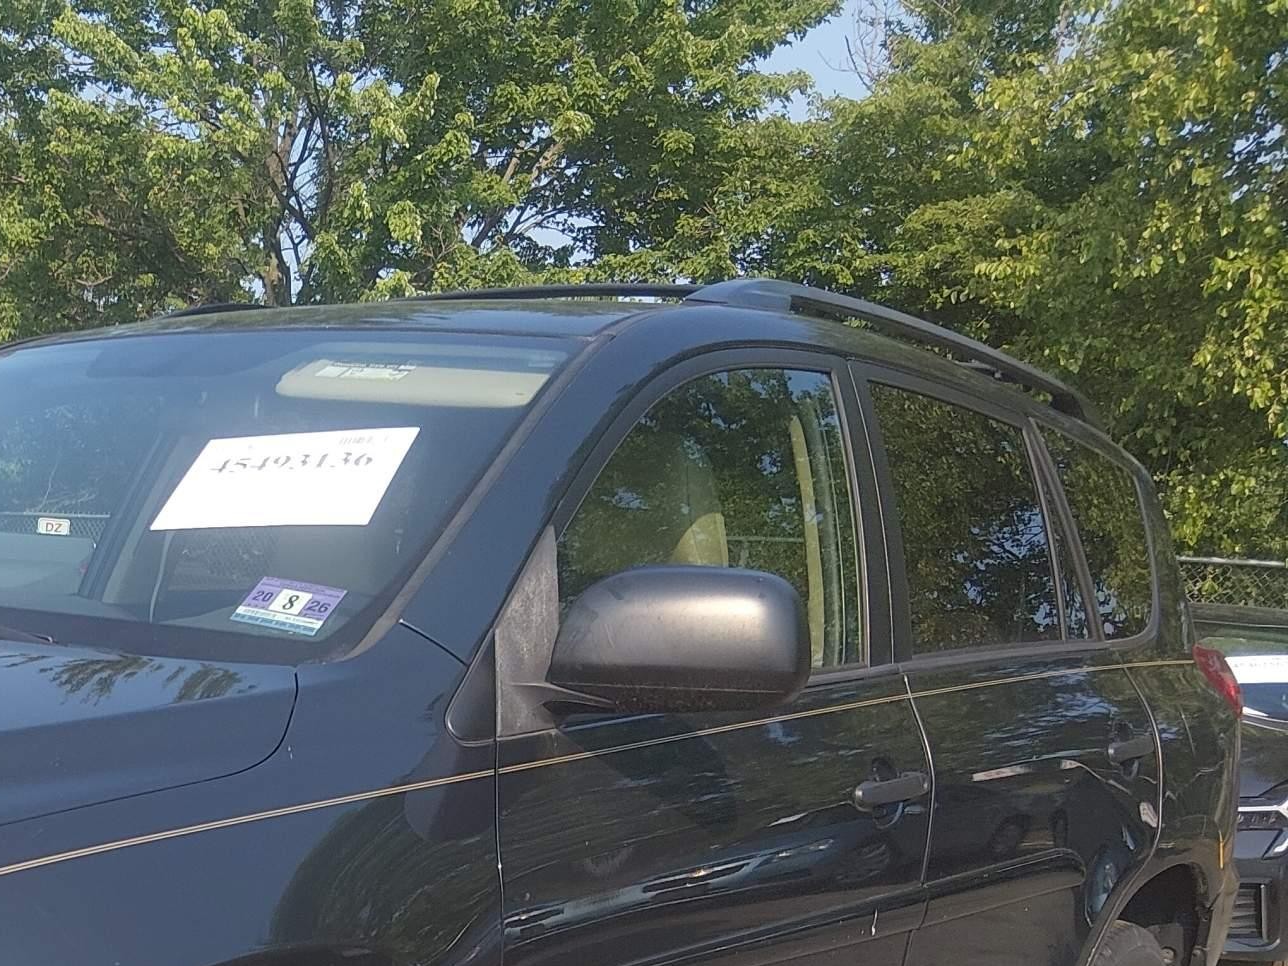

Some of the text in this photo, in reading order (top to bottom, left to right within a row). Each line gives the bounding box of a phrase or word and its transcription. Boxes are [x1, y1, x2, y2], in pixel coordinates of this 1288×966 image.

[45, 522, 63, 533] DZ
[252, 590, 331, 614] 20 8 26
